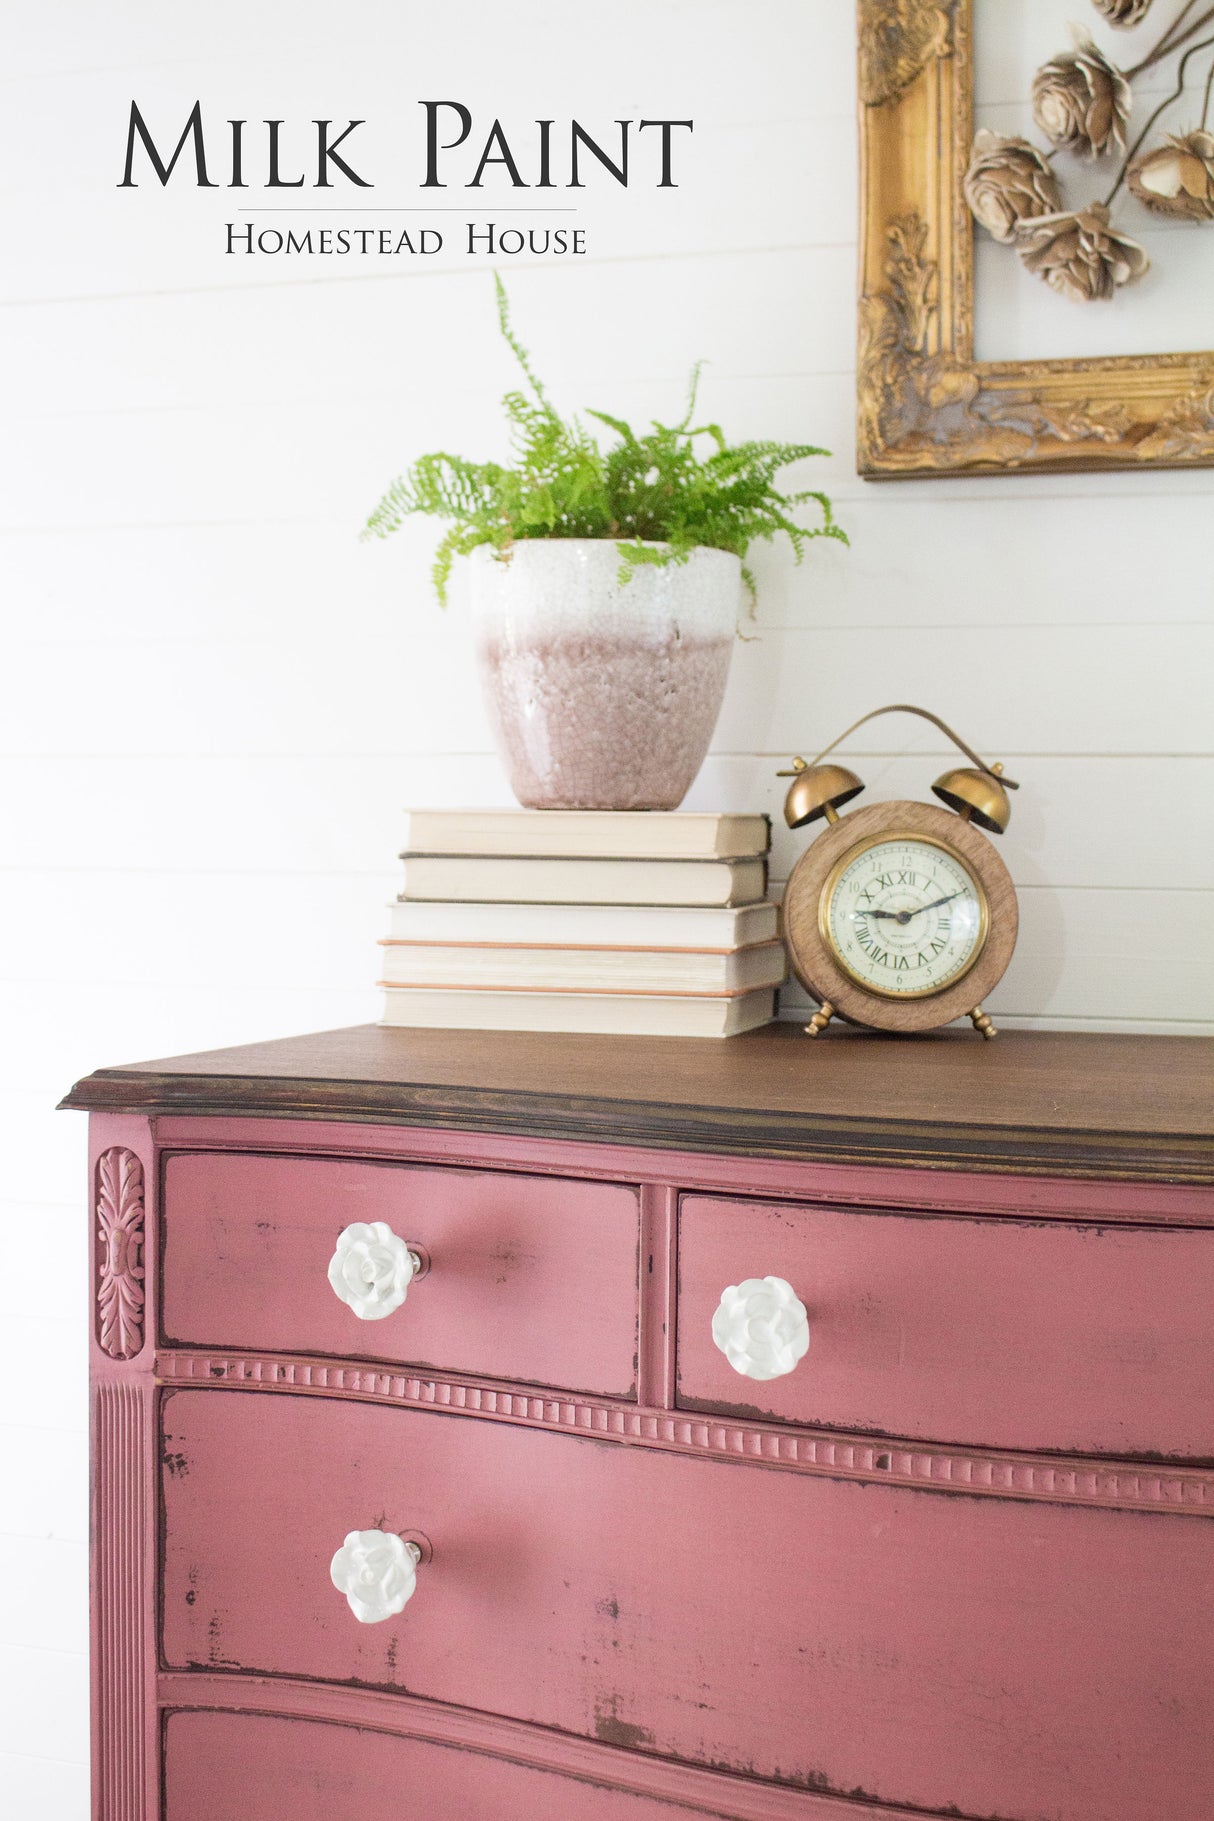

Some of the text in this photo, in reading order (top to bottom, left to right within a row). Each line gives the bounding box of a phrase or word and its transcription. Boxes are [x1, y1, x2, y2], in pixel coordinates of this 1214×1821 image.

[902, 856, 912, 866] 12
[875, 873, 893, 890] XI
[898, 871, 915, 886] XII
